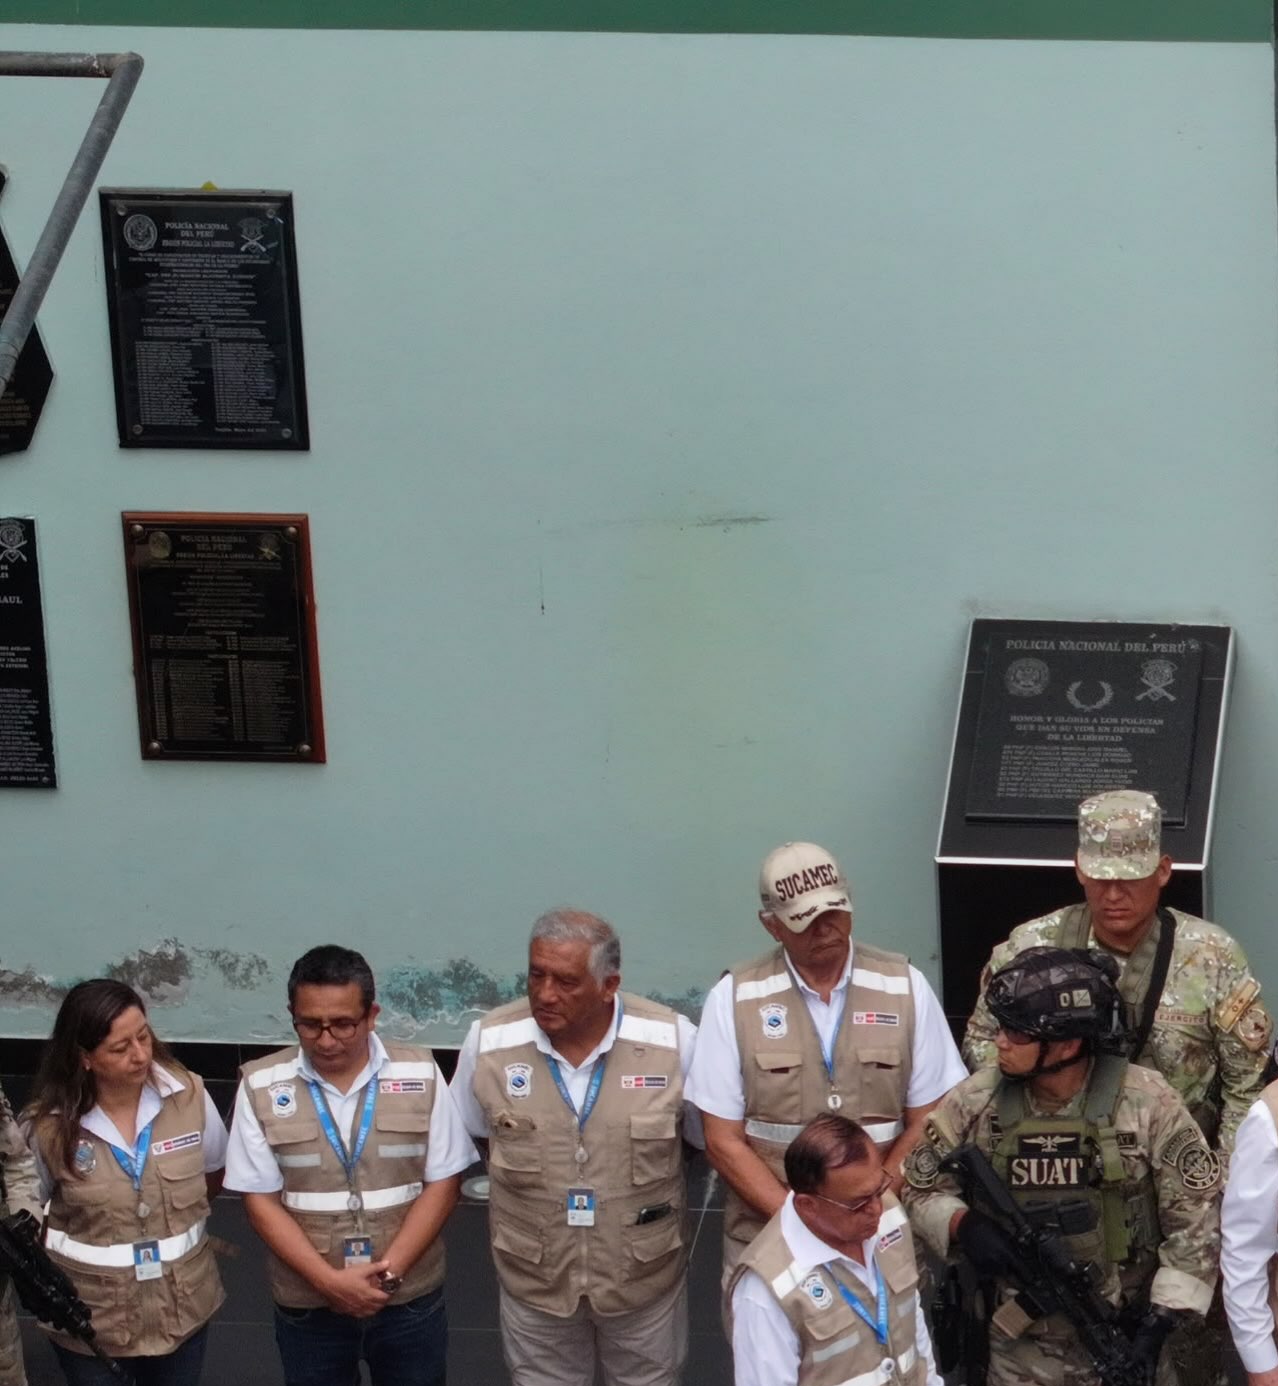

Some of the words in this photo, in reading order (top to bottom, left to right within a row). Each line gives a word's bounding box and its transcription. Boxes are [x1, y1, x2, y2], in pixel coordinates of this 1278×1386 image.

[1059, 640, 1121, 653] NACIONAL
[1124, 642, 1149, 653] DEL
[775, 864, 838, 902] SUCAMEC
[1011, 1158, 1084, 1185] SUAT
